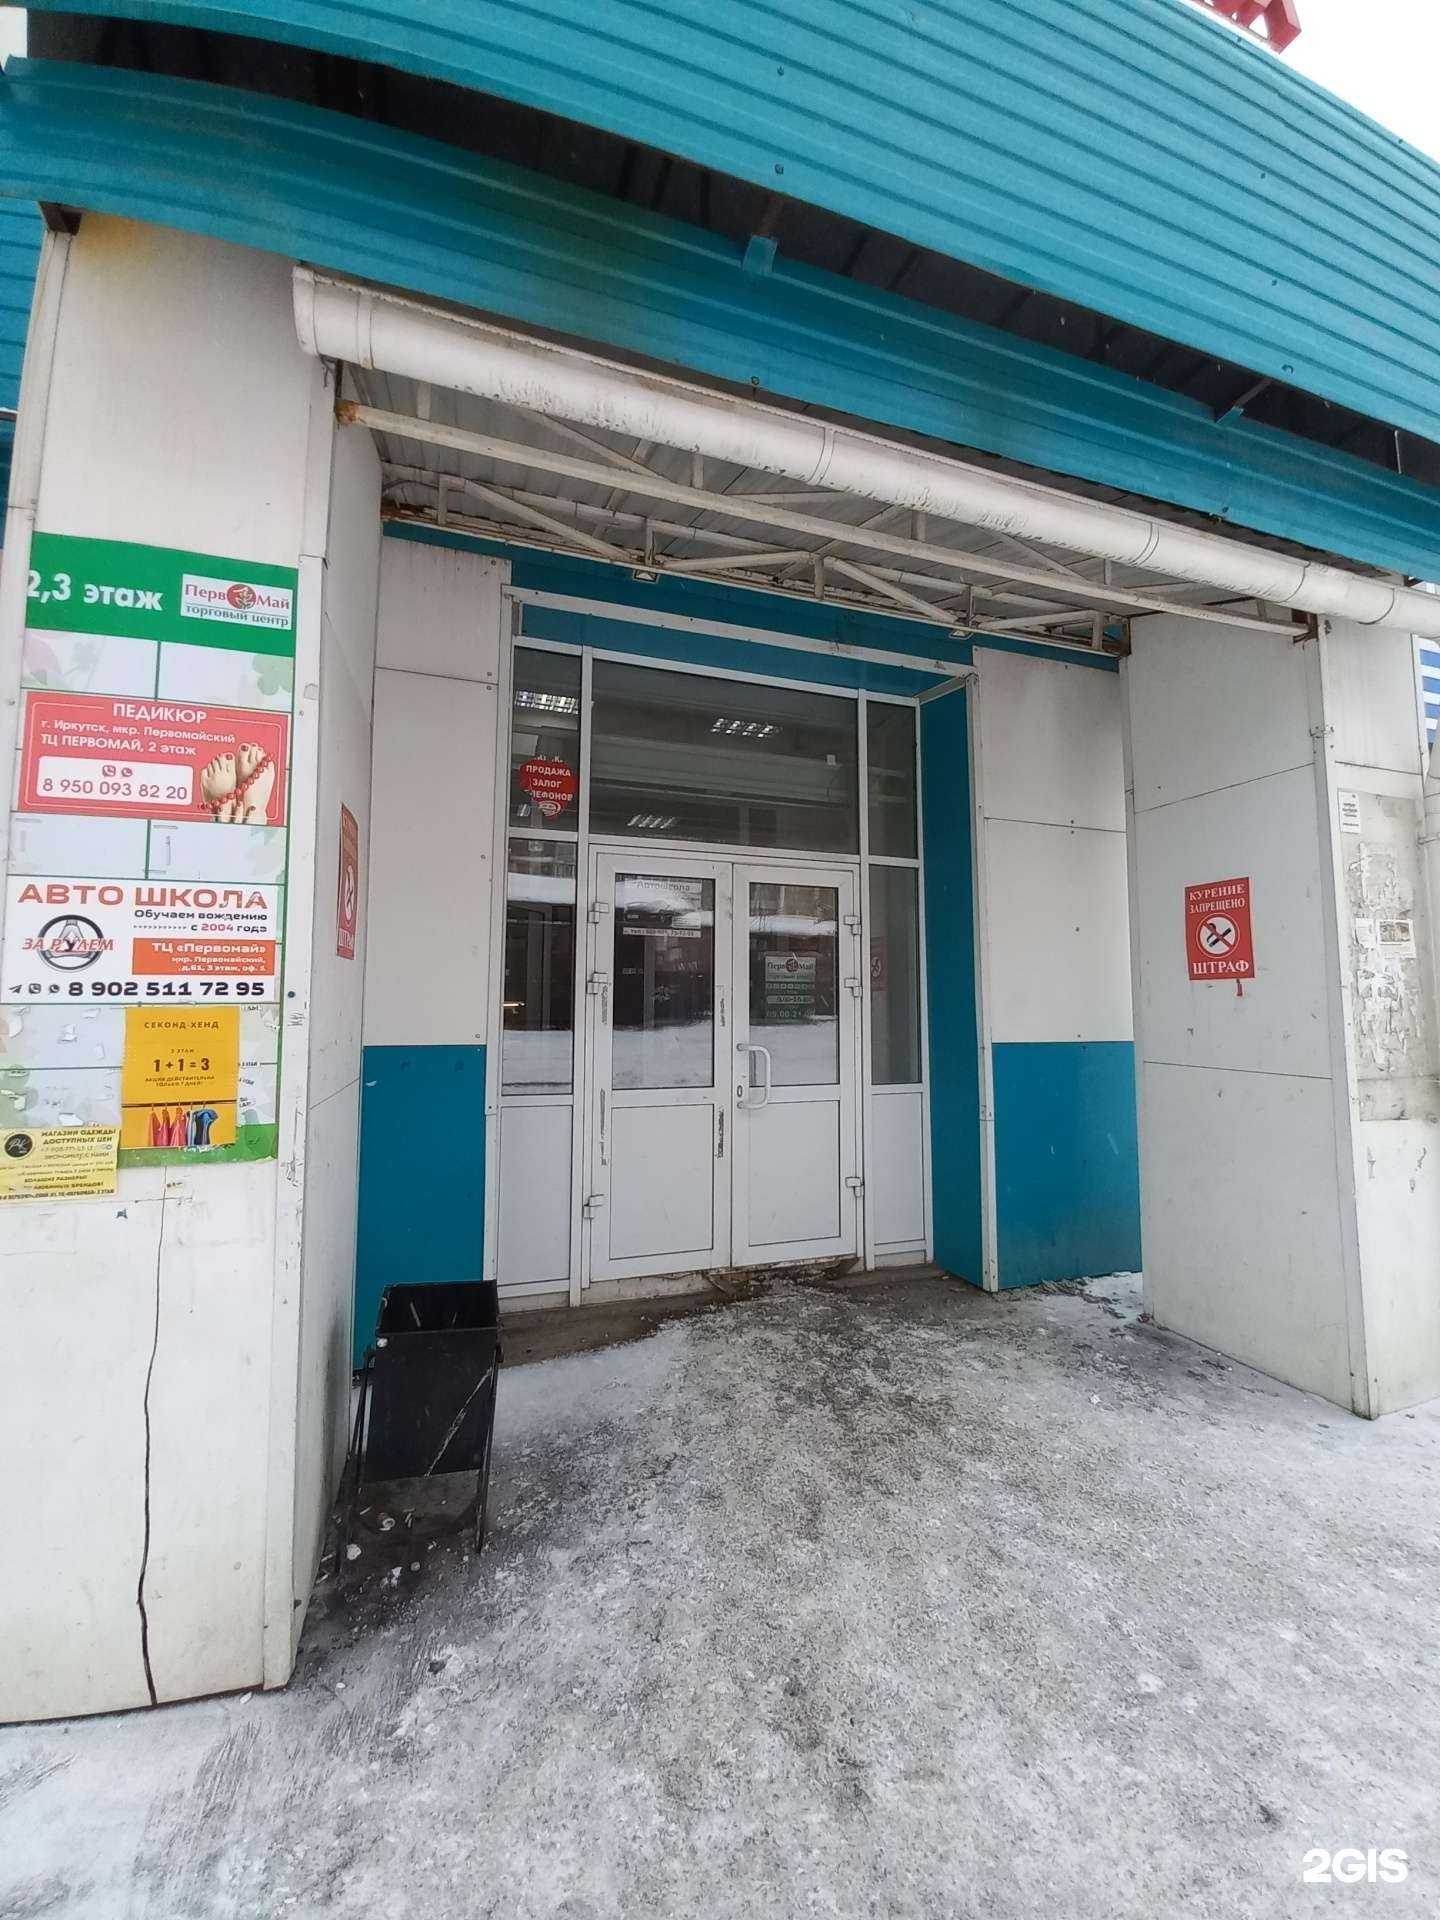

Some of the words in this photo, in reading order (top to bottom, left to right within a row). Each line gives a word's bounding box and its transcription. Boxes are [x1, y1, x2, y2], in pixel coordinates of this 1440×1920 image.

[27, 569, 72, 603] 2,3
[83, 584, 164, 611] этаж
[186, 604, 248, 622] торговый
[251, 613, 289, 628] центр
[113, 703, 207, 724] ПЕДИКЮР
[41, 720, 50, 729] г.
[54, 720, 109, 734] Иркутск,
[112, 726, 140, 737] мкр.
[144, 726, 236, 744] Первомайский
[40, 733, 58, 747] ТЦ
[62, 735, 144, 753] ПЕРВОМАЙ,
[148, 743, 157, 752] 2
[160, 744, 198, 756] этаж
[525, 764, 571, 776] ПРОДАЖА
[42, 778, 54, 792] 8
[60, 779, 93, 794] 950
[99, 781, 132, 796] 093
[138, 784, 160, 798] 82
[166, 786, 188, 800] 20
[532, 778, 562, 788] ЗАЛОГ
[17, 883, 124, 906] АВТО
[134, 887, 268, 909] ШКОЛА
[1189, 883, 1245, 901] КУРЕНИЕ
[1189, 897, 1246, 914] ЗАПРЕЩЕНО
[134, 909, 195, 921] Обучаем
[198, 912, 268, 922] вождению
[201, 923, 234, 932] 2004
[236, 925, 267, 934] года
[22, 938, 45, 950] ЗА
[151, 942, 174, 954] ТЦ
[176, 942, 266, 955] «Первомай»
[1192, 959, 1250, 975] ШТРАФ
[68, 982, 83, 997] 8
[91, 981, 139, 996] 902
[145, 982, 192, 996] 511
[199, 982, 229, 996] 72
[236, 981, 265, 996] 95
[144, 1020, 220, 1029] СЕКОНД-ХЕНД
[153, 1059, 161, 1072] 1
[178, 1058, 184, 1071] 1
[200, 1057, 210, 1071] 3
[43, 1137, 96, 1145] ДОСТУПНЫХ
